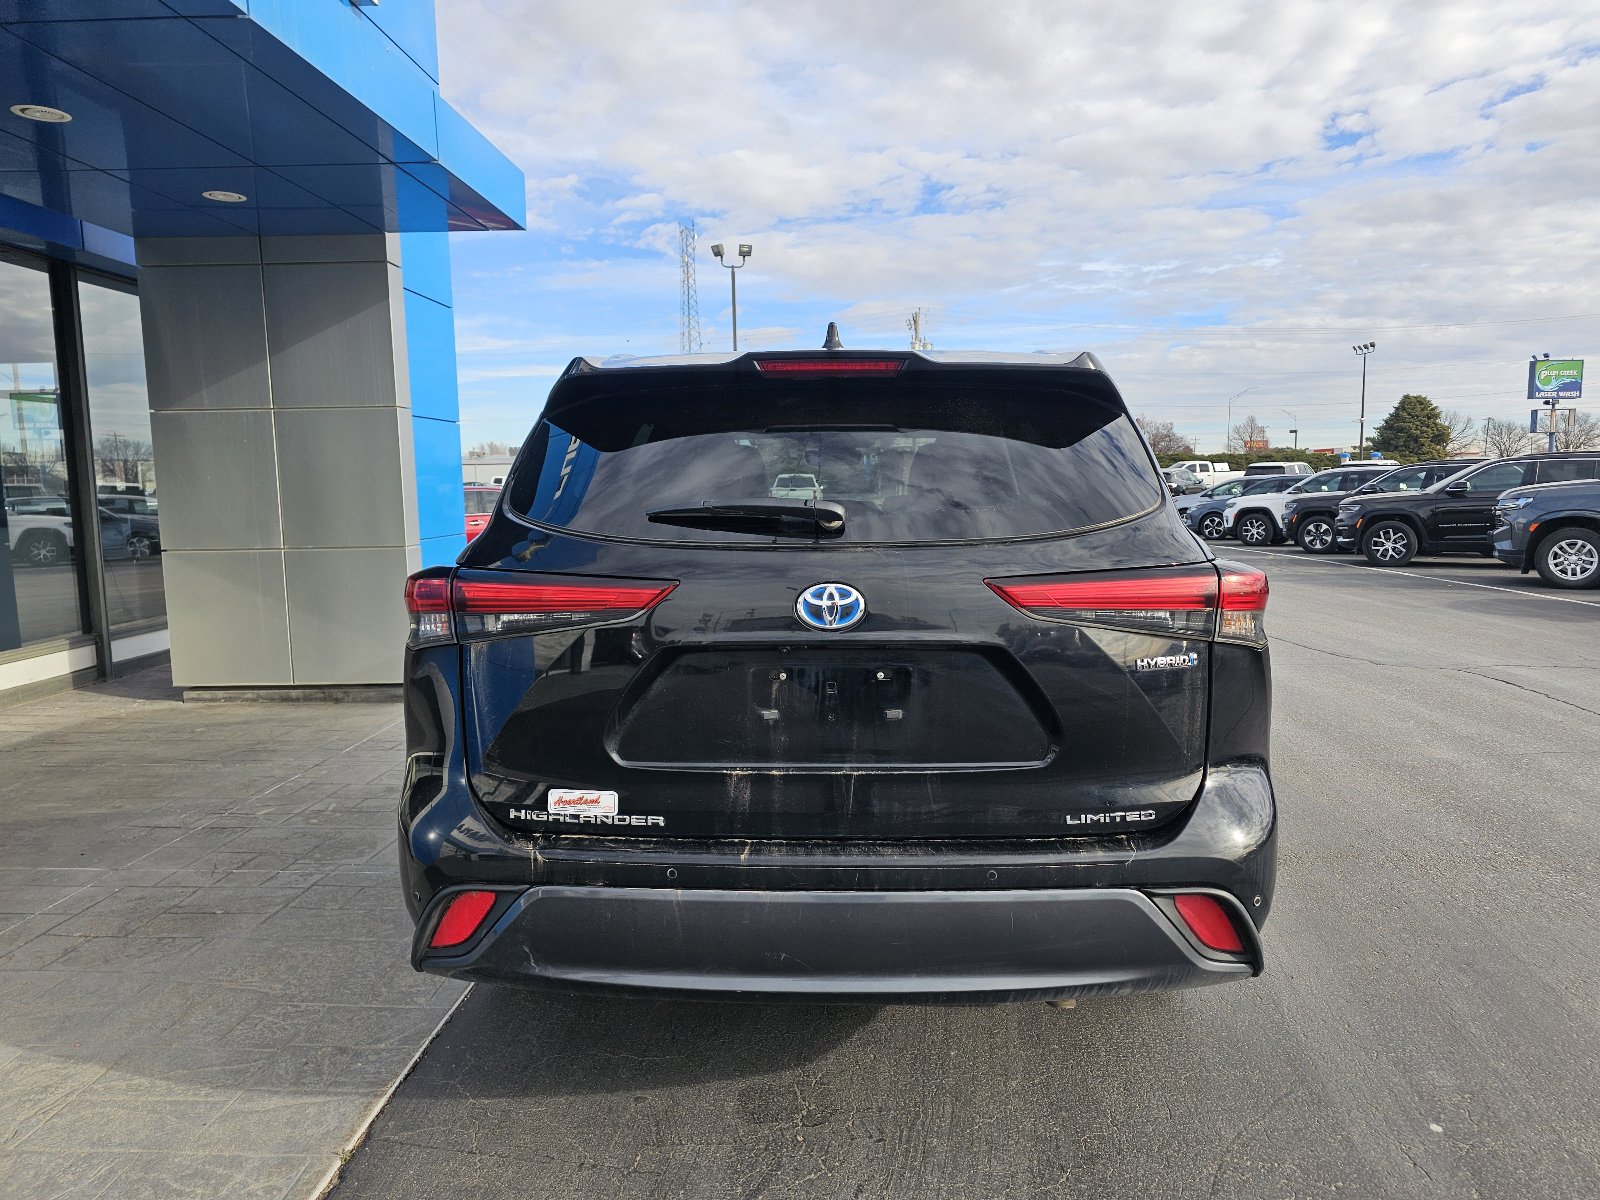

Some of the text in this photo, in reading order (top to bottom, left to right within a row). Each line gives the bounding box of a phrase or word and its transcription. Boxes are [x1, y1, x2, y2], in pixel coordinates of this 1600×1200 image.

[1541, 370, 1558, 380] PLUM
[1135, 656, 1189, 670] HYBRID
[509, 808, 665, 827] HIGHLANDER
[1065, 810, 1156, 825] LIMITED
